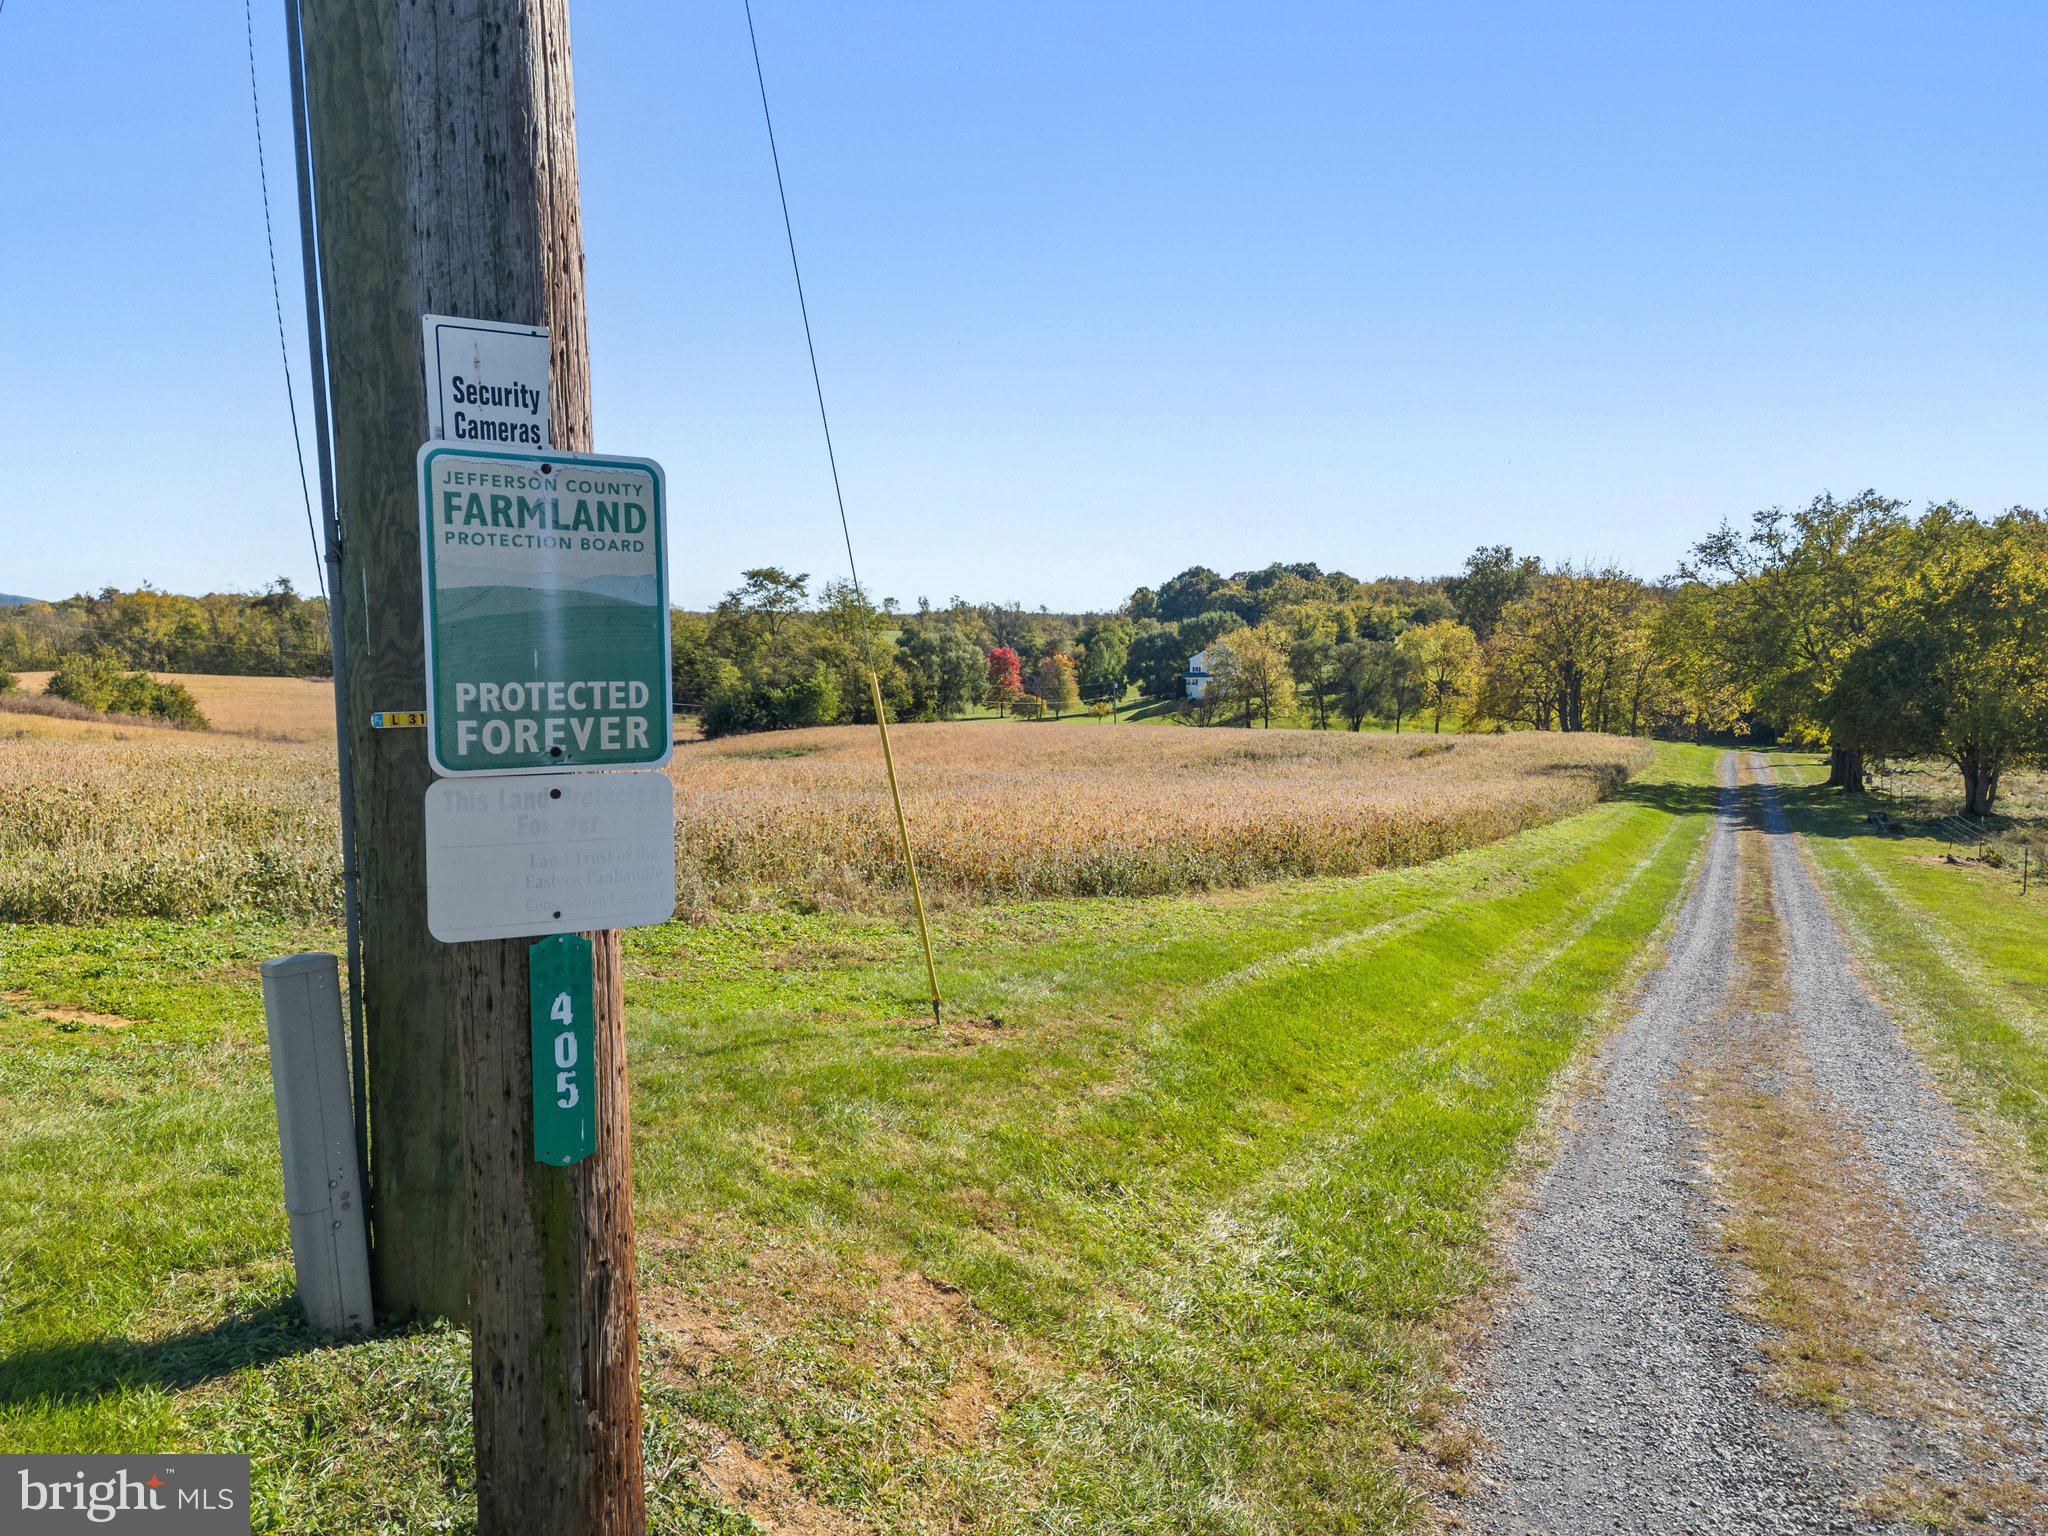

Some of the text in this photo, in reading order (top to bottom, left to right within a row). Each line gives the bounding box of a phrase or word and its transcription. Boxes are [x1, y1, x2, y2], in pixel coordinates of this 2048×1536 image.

[452, 376, 540, 415] Security
[454, 412, 541, 444] Cameras
[443, 471, 643, 497] JEFFERSON COUNTY
[443, 491, 647, 534] FARMLAND
[445, 531, 645, 553] PROTECTION BOARD
[455, 680, 650, 713] PROTECTED
[457, 716, 650, 756] FOREVER
[442, 789, 488, 814] This
[499, 786, 549, 812] Land
[575, 849, 612, 866] Trust
[525, 871, 582, 890] Eastern
[551, 991, 580, 1109] 405
